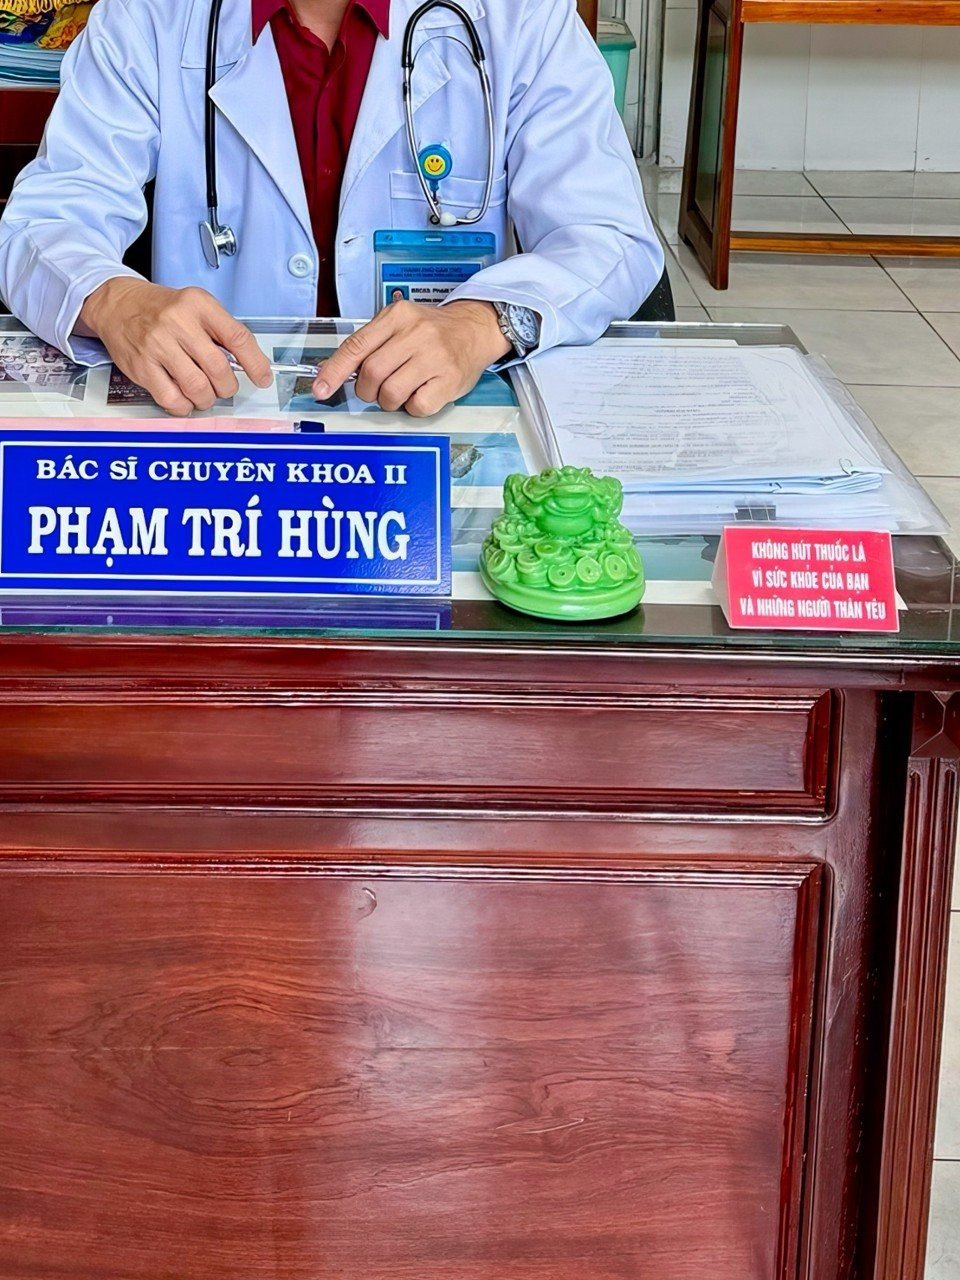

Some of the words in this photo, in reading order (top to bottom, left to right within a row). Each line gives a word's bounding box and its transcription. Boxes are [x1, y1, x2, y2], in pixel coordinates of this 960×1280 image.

[36, 454, 99, 481] BÁC
[109, 455, 138, 480] SĨ
[148, 457, 276, 483] CHUYÊN
[286, 463, 375, 485] KHOA
[384, 464, 408, 485] II
[27, 505, 169, 568] PHẠM
[181, 494, 263, 558] TRÍ
[277, 496, 411, 561] HÙNG
[751, 538, 789, 560] KHÔNG
[791, 539, 811, 561] HÚT
[814, 538, 850, 562] THUỐC
[852, 541, 867, 563] LÁ
[751, 567, 763, 587] VÌ
[766, 566, 788, 588] SỨC
[790, 564, 819, 589] KHỎE
[821, 565, 844, 590] CỦA
[846, 573, 870, 595] BẠN
[739, 595, 755, 616] VÀ
[757, 595, 795, 617] NHỮNG
[797, 596, 832, 618] NGƯỜI
[833, 599, 863, 619] THÂN
[864, 598, 887, 620] YÊU
